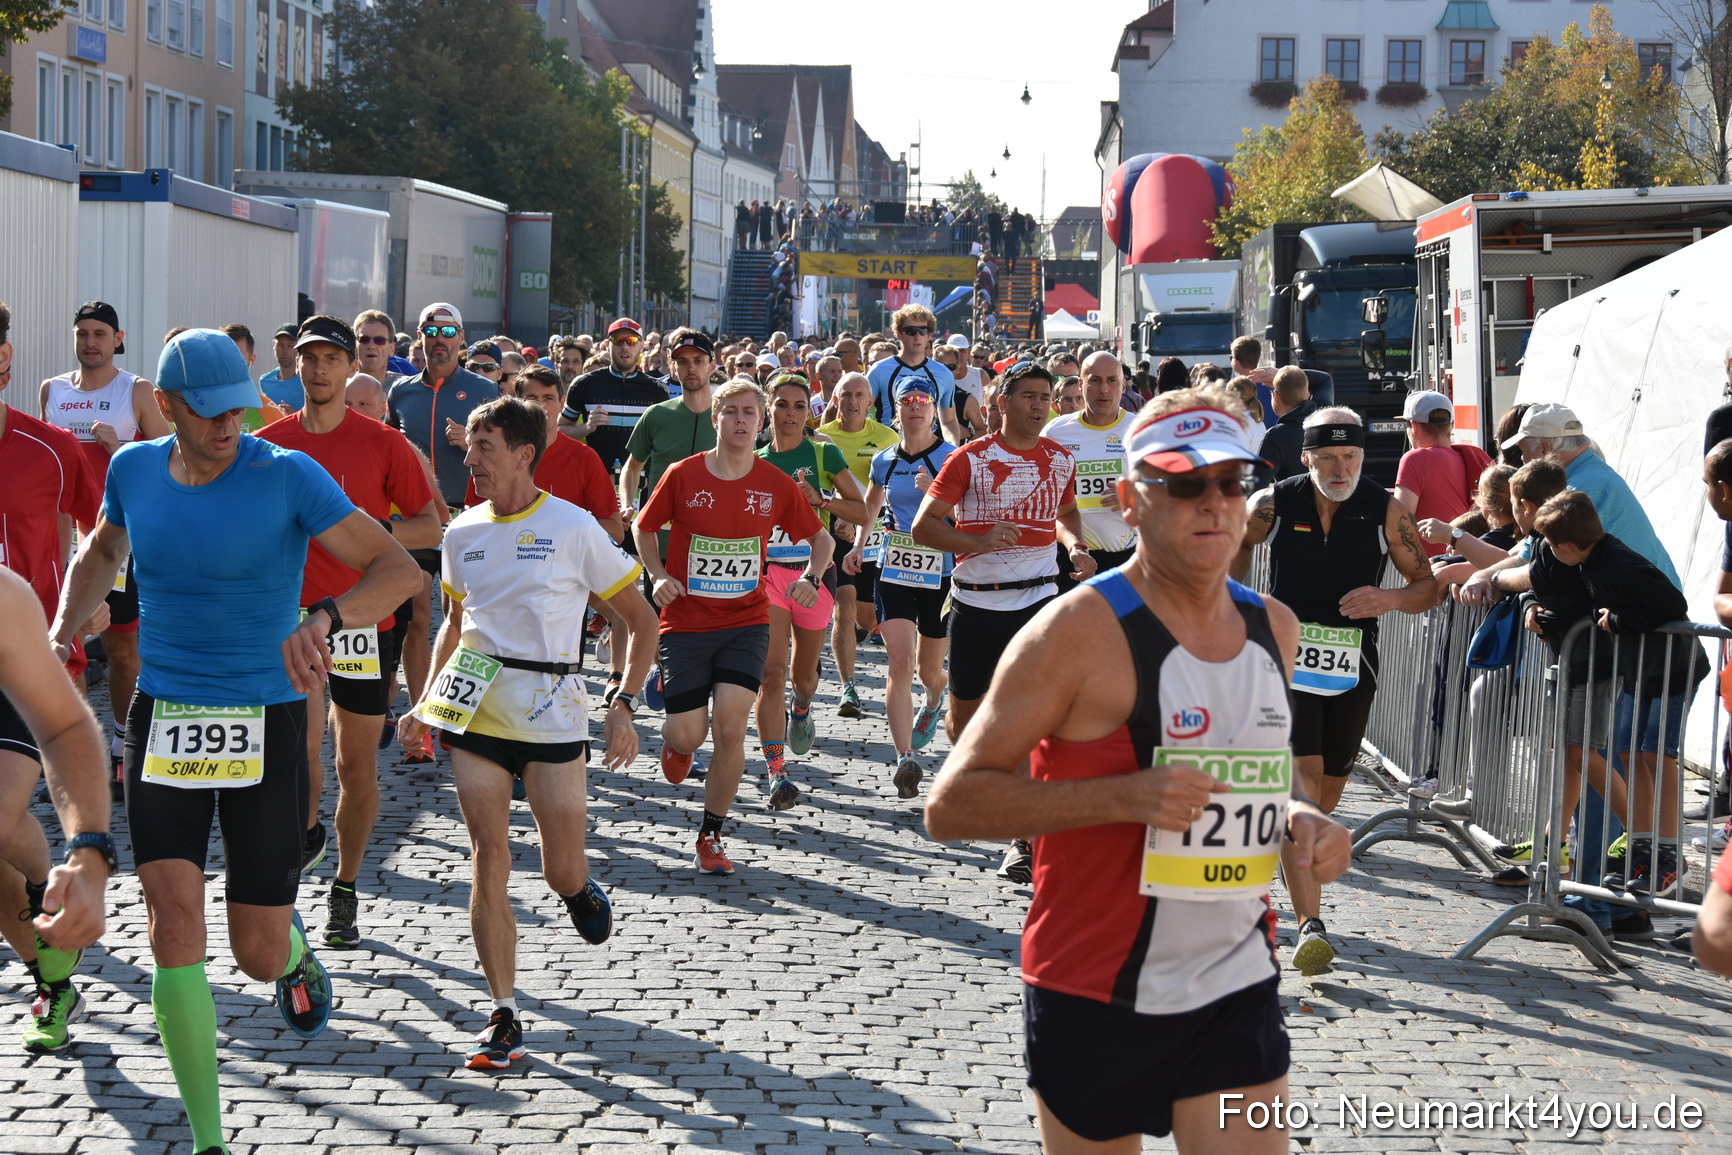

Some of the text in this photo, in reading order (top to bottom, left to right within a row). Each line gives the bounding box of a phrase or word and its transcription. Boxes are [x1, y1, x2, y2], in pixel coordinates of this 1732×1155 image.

[857, 259, 918, 274] START
[1167, 287, 1214, 296] BOCK
[1368, 371, 1409, 380] MAN
[60, 400, 93, 411] speck
[1176, 420, 1202, 432] tkn
[1076, 461, 1118, 474] OCK
[518, 533, 535, 545] 20
[694, 537, 755, 554] BOCK
[891, 534, 932, 549] BO
[696, 558, 752, 578] 2247
[891, 550, 936, 571] 2637
[897, 572, 925, 583] ANIKA
[700, 581, 746, 591] MANUEL
[325, 633, 369, 656] 310
[332, 662, 363, 671] RGEN
[451, 652, 493, 678] OCK
[435, 673, 476, 706] 1052
[427, 704, 463, 722] HERBERT
[1172, 709, 1203, 728] tkn
[165, 724, 249, 754] 1393
[1203, 864, 1247, 882] UDO
